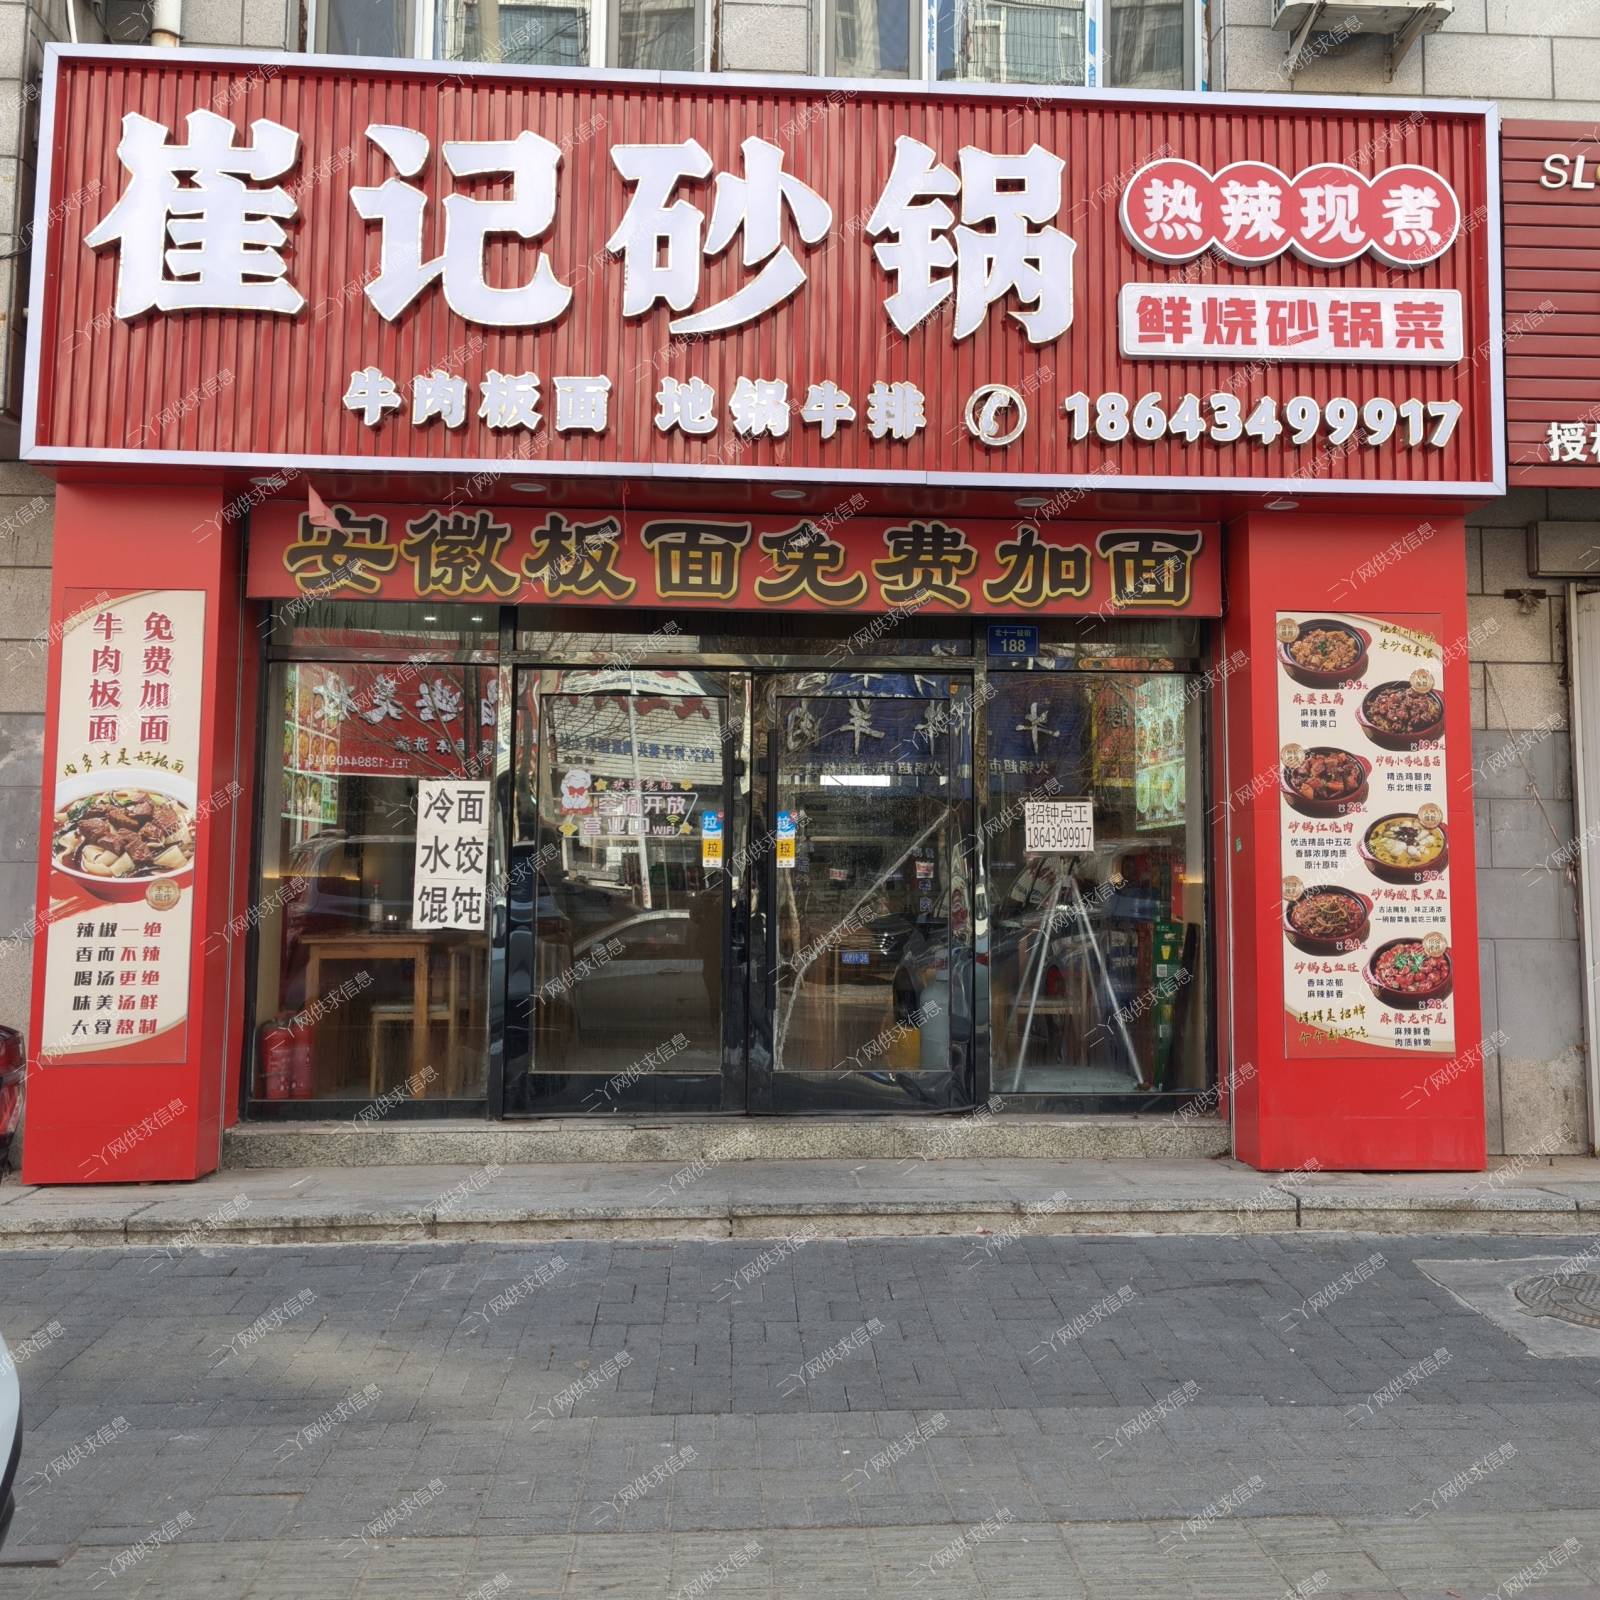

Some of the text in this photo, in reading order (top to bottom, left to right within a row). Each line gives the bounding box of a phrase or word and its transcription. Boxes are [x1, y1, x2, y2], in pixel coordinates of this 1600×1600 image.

[1541, 153, 1600, 189] SL
[1144, 178, 1443, 245] 热辣现煮
[84, 109, 1076, 344] 崔记砂锅
[1136, 296, 1445, 349] 鲜烧砂锅菜
[343, 366, 1461, 448] 牛肉板面 地锅牛排 18643499917
[283, 504, 1202, 609] 安徽板面免费加面
[1001, 639, 1026, 652] 188
[89, 612, 122, 742] 牛肉板面
[139, 611, 174, 742] 免费加面
[1300, 708, 1337, 718] 麻辣鲜香
[1387, 783, 1432, 792] 东北地标菜
[424, 788, 485, 824] 冷面
[599, 796, 686, 816] 空调开放
[1031, 804, 1088, 824] 招钟点工
[584, 817, 649, 835] 营业中
[1028, 827, 1091, 848] 18643499917
[420, 836, 484, 874] 水饺
[418, 886, 481, 924] 馄饨
[76, 922, 162, 938] 辣椒一绝
[75, 946, 160, 962] 香而不辣
[74, 970, 160, 986] 喝汤更绝
[72, 994, 158, 1010] 味美汤鲜
[1307, 990, 1343, 999] 麻辣鲜香
[71, 1019, 157, 1035] 大骨熬制
[1395, 1028, 1430, 1036] 麻辣鲜香
